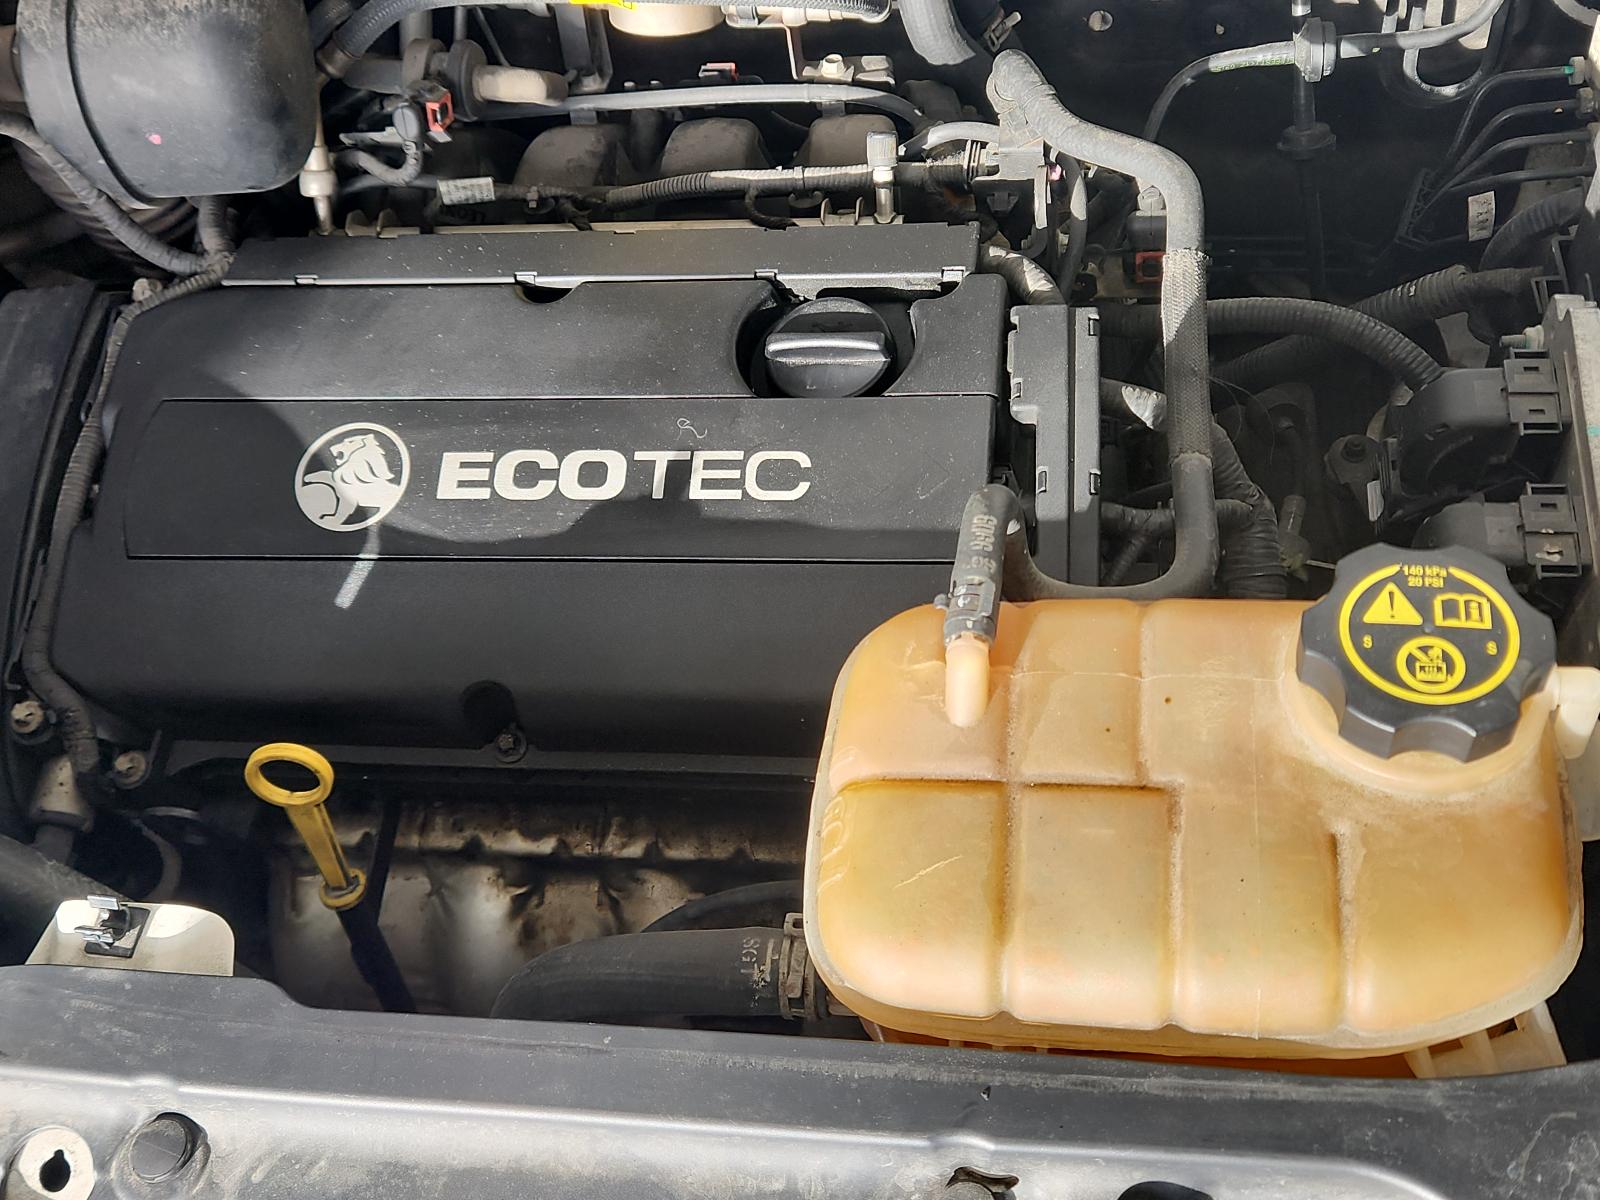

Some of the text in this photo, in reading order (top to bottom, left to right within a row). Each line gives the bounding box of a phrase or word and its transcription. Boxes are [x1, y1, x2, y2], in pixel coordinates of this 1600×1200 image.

[437, 449, 813, 501] ECOTEC
[1402, 565, 1447, 577] 140 kPa
[1408, 575, 1444, 588] 20 PSI
